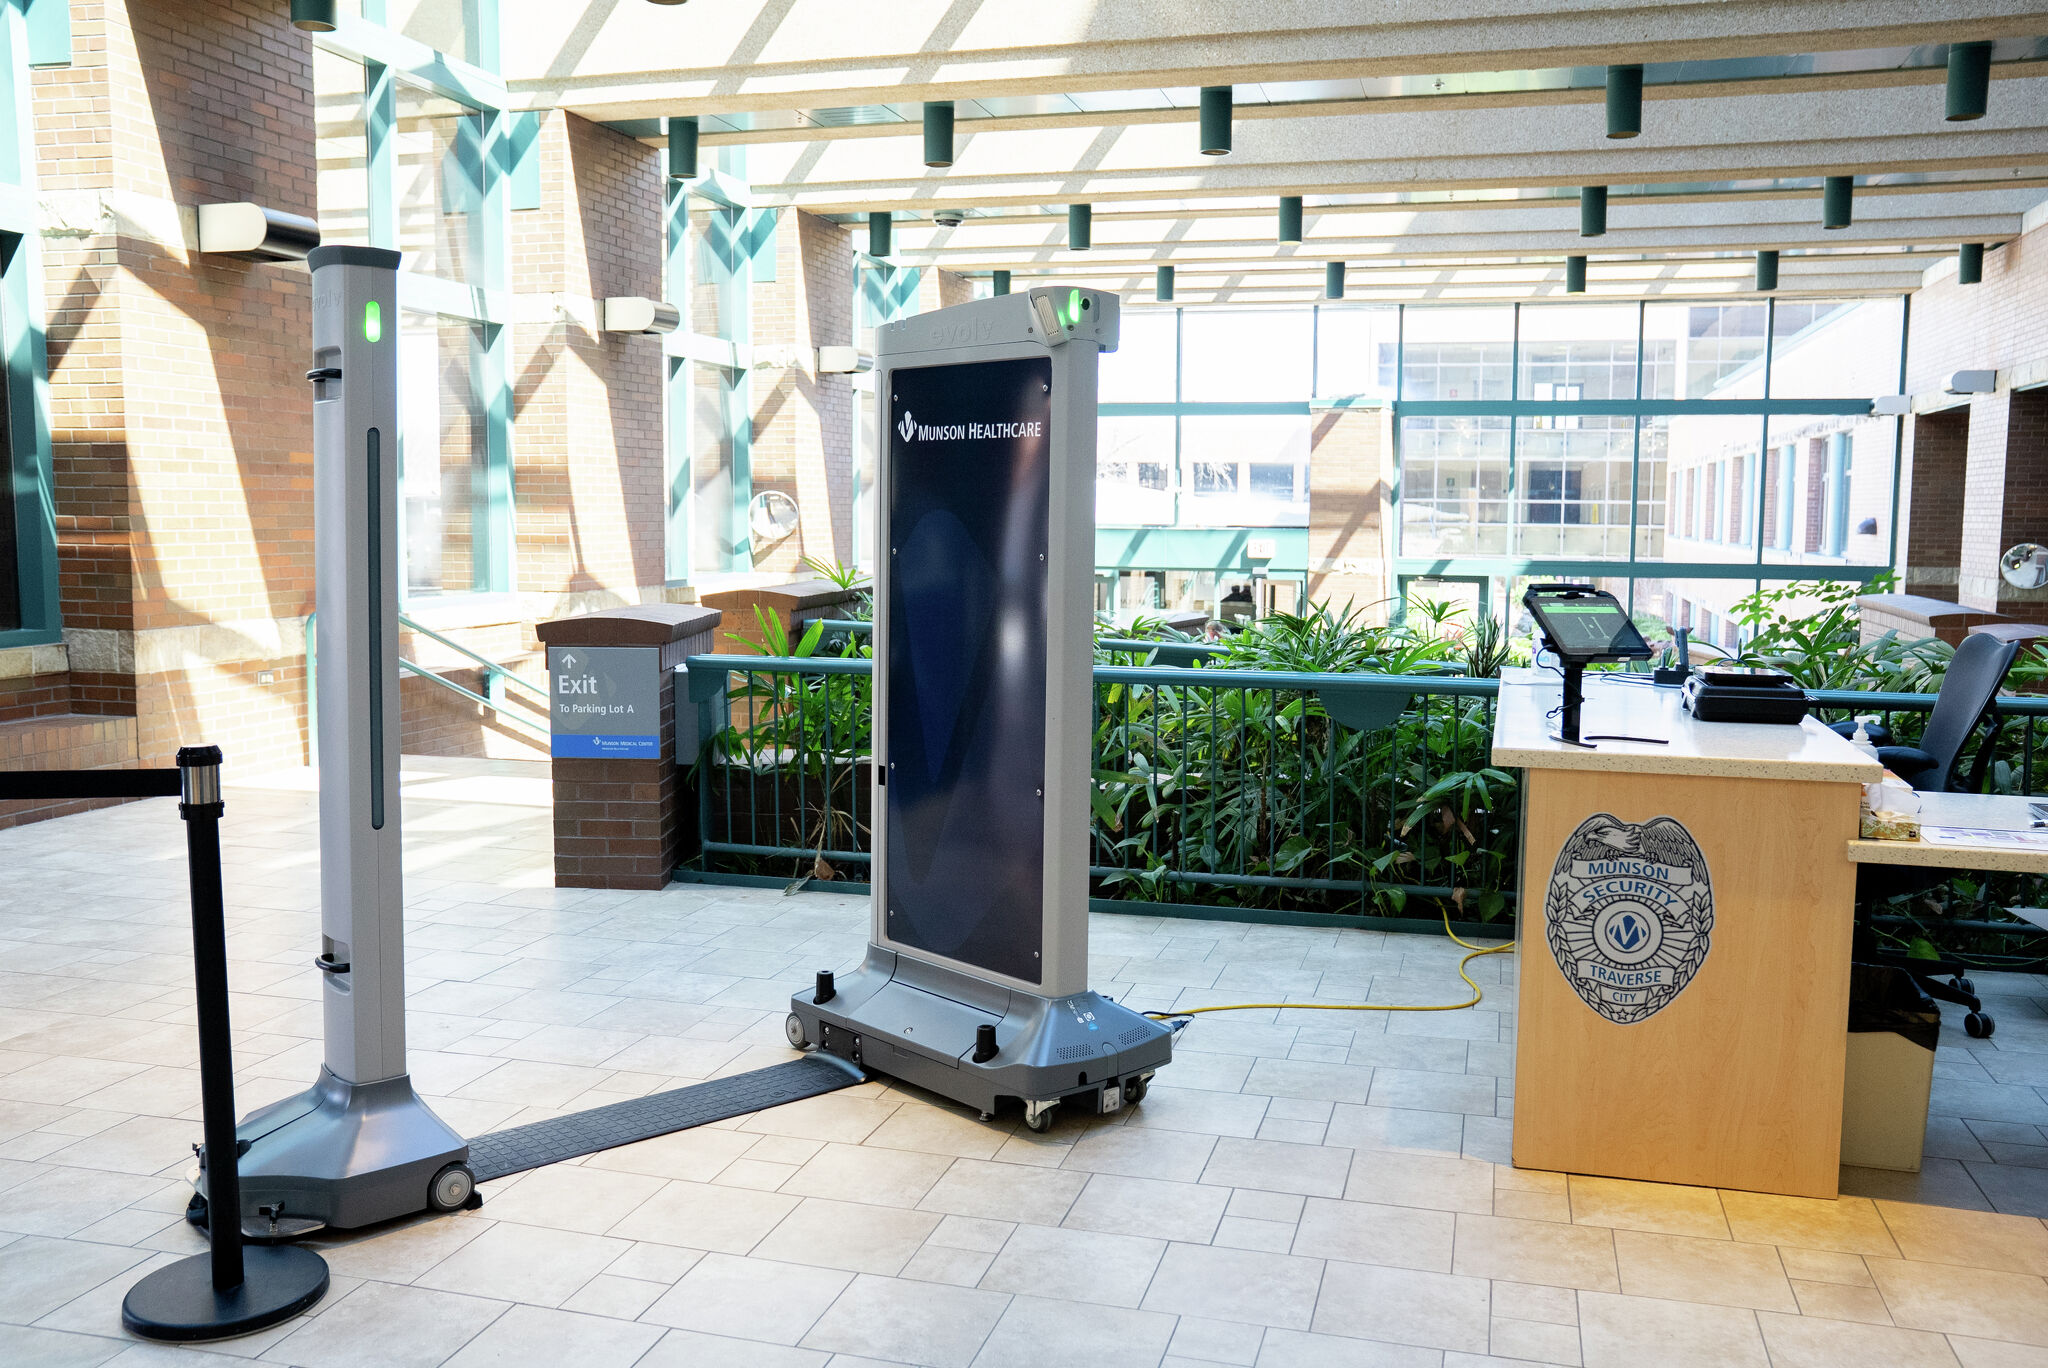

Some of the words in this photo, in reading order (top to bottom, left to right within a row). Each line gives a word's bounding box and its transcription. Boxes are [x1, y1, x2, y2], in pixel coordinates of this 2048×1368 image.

[918, 424, 966, 441] MUNSON
[968, 422, 1042, 440] HEALTHCARE
[558, 675, 597, 694] Exit
[560, 704, 570, 713] To
[572, 703, 607, 715] Parking
[609, 704, 624, 713] Lot
[627, 704, 634, 713] A
[1587, 861, 1670, 880] MUNSON
[1582, 880, 1679, 907] SECURITY
[1589, 964, 1662, 986] TRAVERSE
[1612, 991, 1637, 1003] CITY
